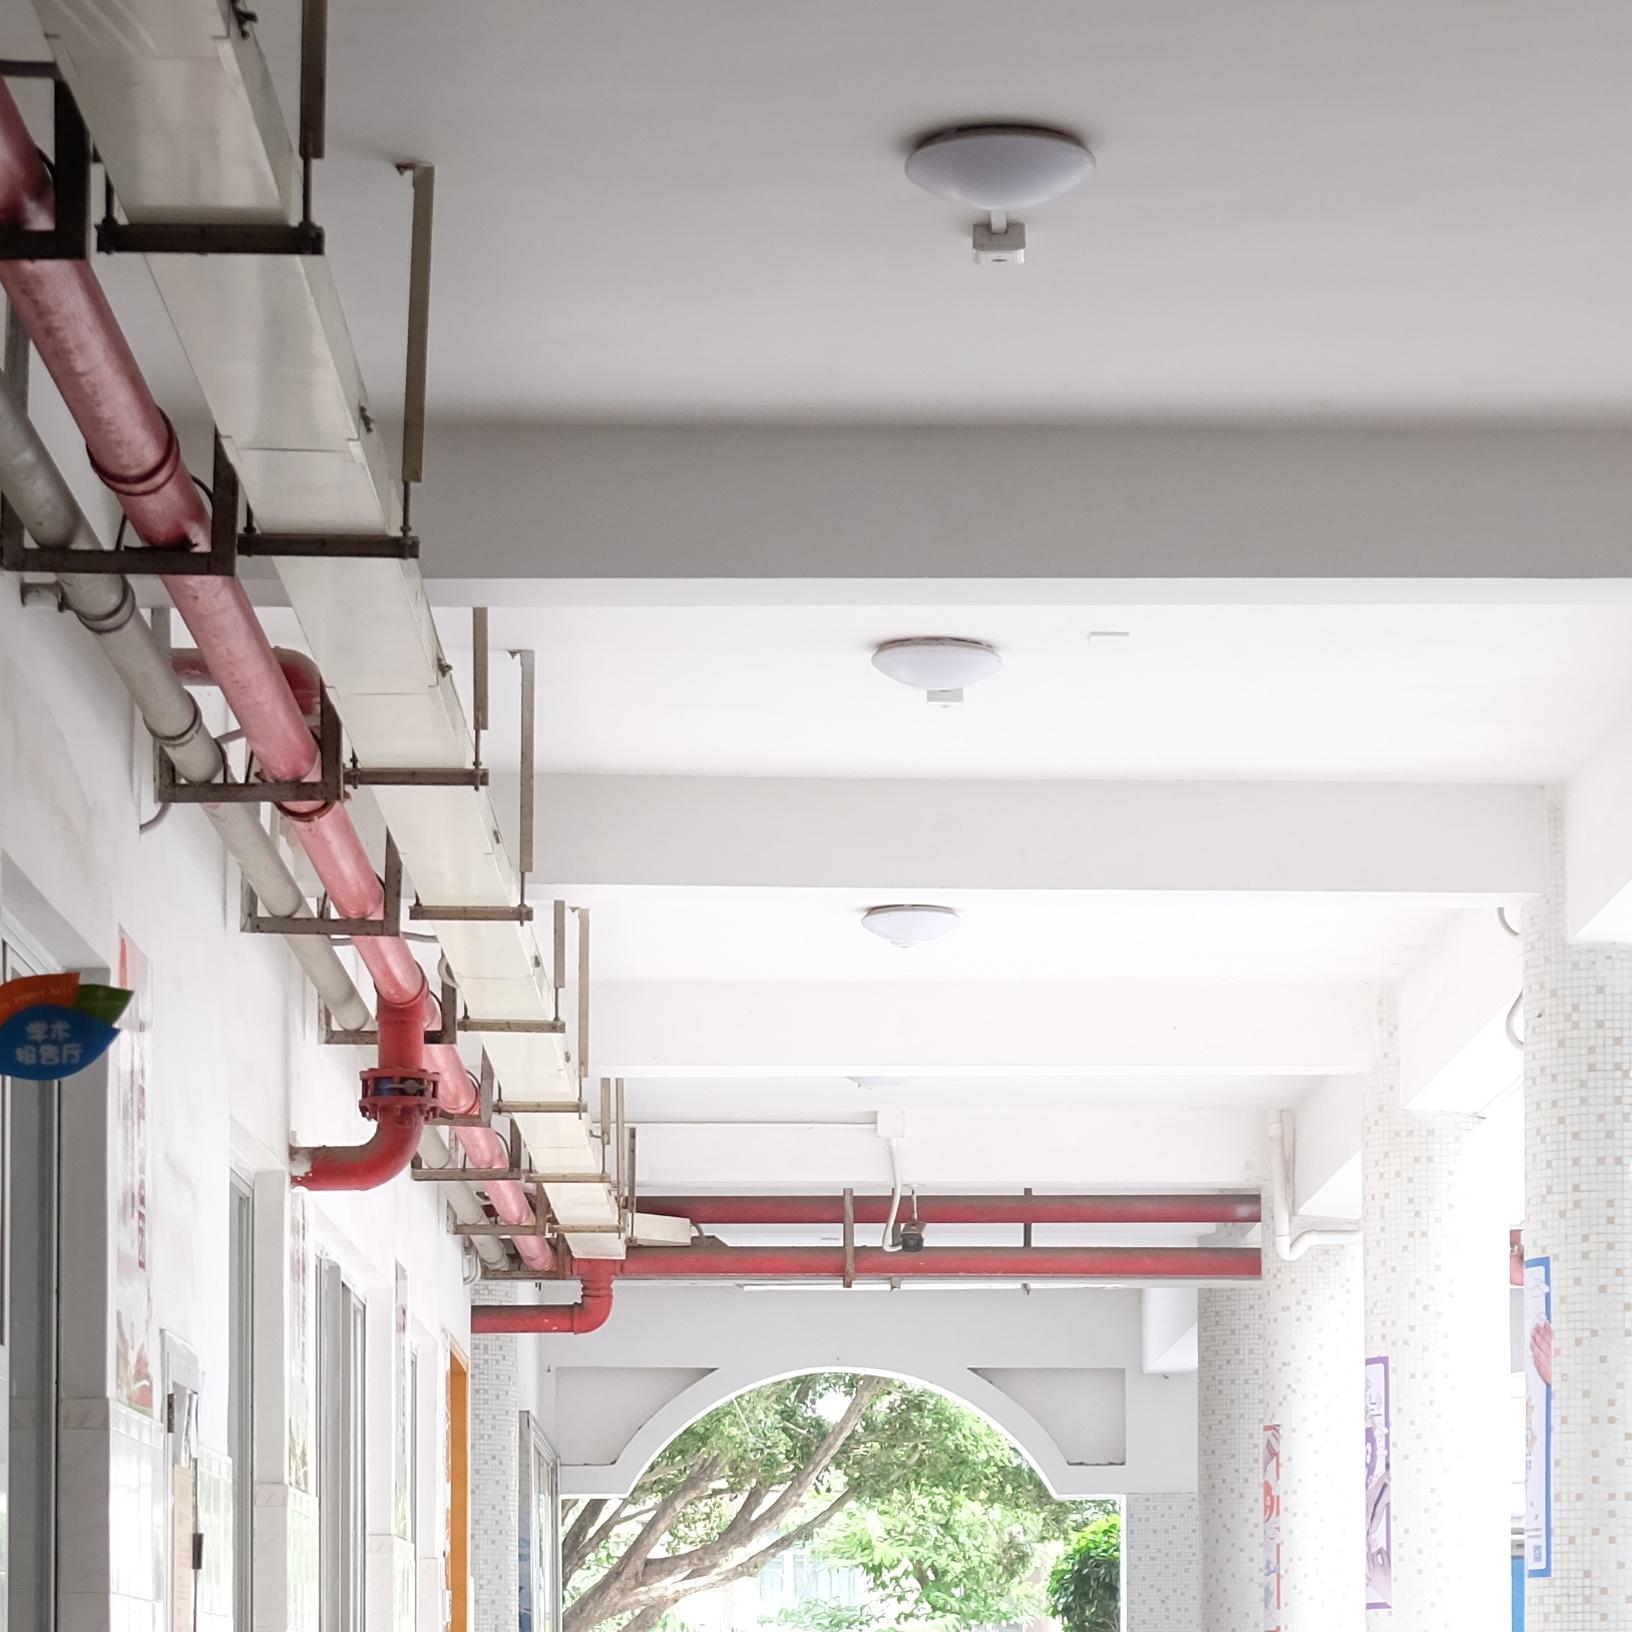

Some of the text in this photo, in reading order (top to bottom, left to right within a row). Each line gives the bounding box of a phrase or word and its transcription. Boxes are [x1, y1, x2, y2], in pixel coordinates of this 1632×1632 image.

[25, 1020, 72, 1042] 学术
[15, 1043, 83, 1066] 报告厅
